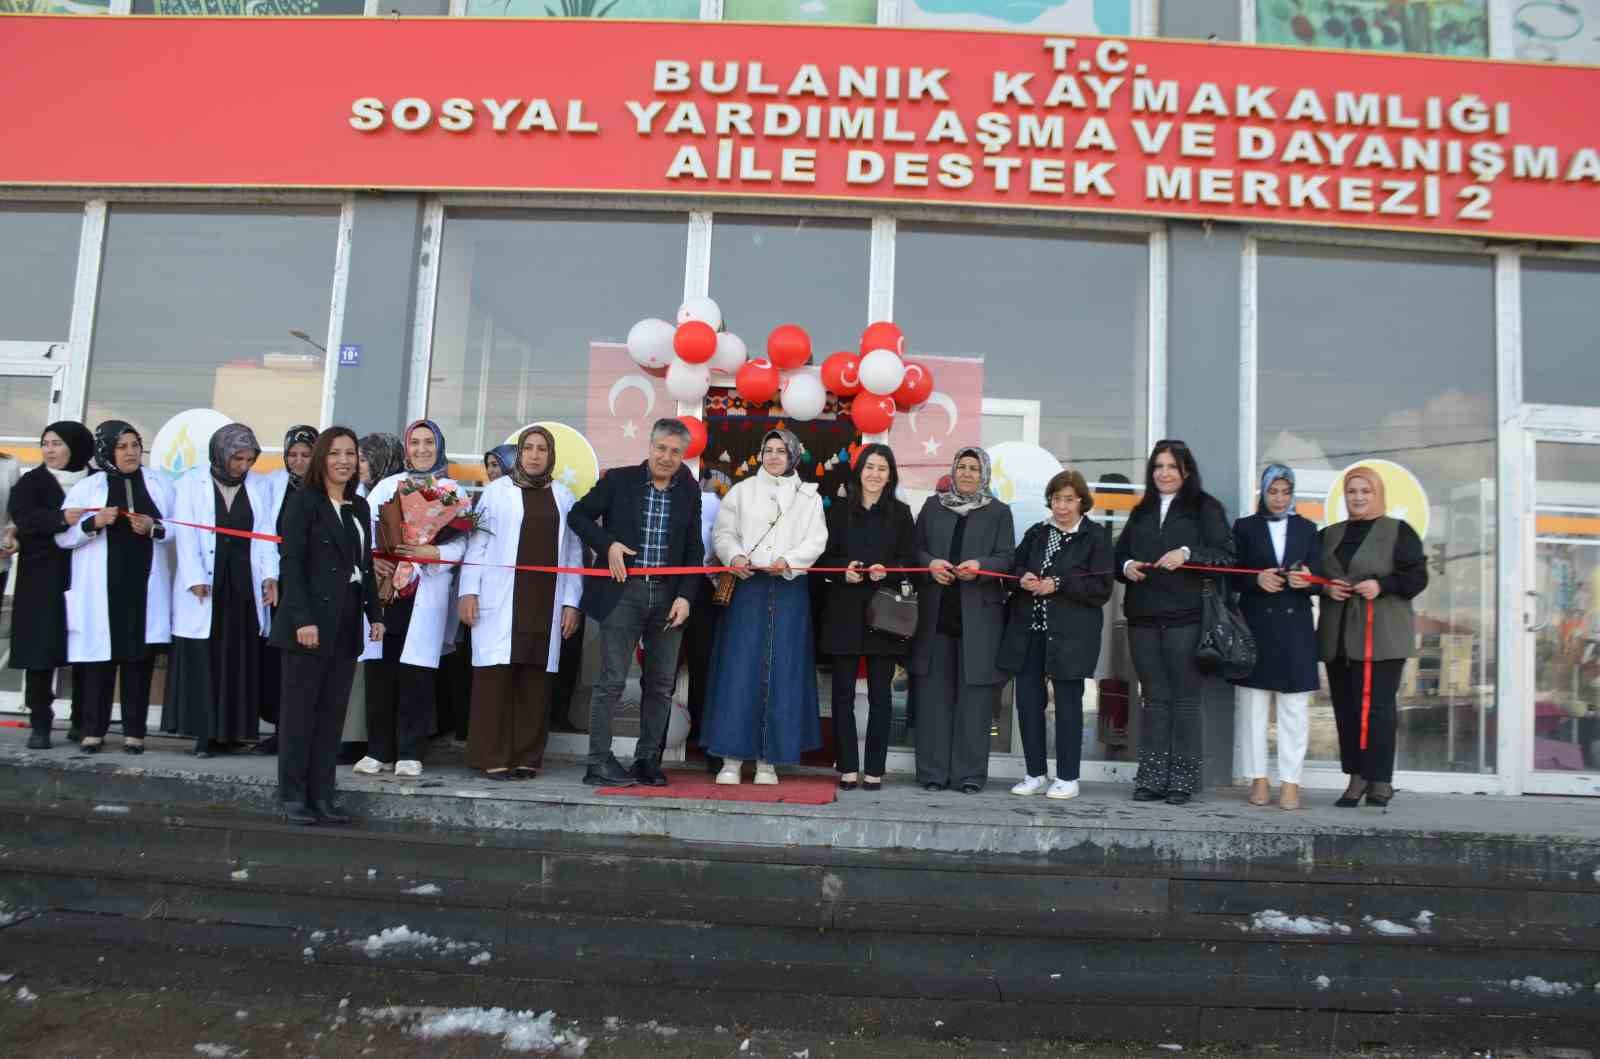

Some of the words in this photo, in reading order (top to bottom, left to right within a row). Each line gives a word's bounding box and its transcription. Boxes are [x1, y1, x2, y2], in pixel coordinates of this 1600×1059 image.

[1044, 39, 1147, 74] T.C.
[654, 60, 949, 101] BULANIK
[993, 71, 1510, 134] KAYMAKAMLIĞI
[349, 98, 598, 132] SOSYAL
[626, 101, 1117, 154] YARDIMLAŞMA
[1132, 121, 1217, 157] VE
[1238, 127, 1600, 183] DAYANIŞMA
[666, 138, 816, 183] AİLE
[847, 152, 1117, 197] DESTEK
[1146, 166, 1440, 218] MERKEZİ
[1457, 185, 1494, 220] 2
